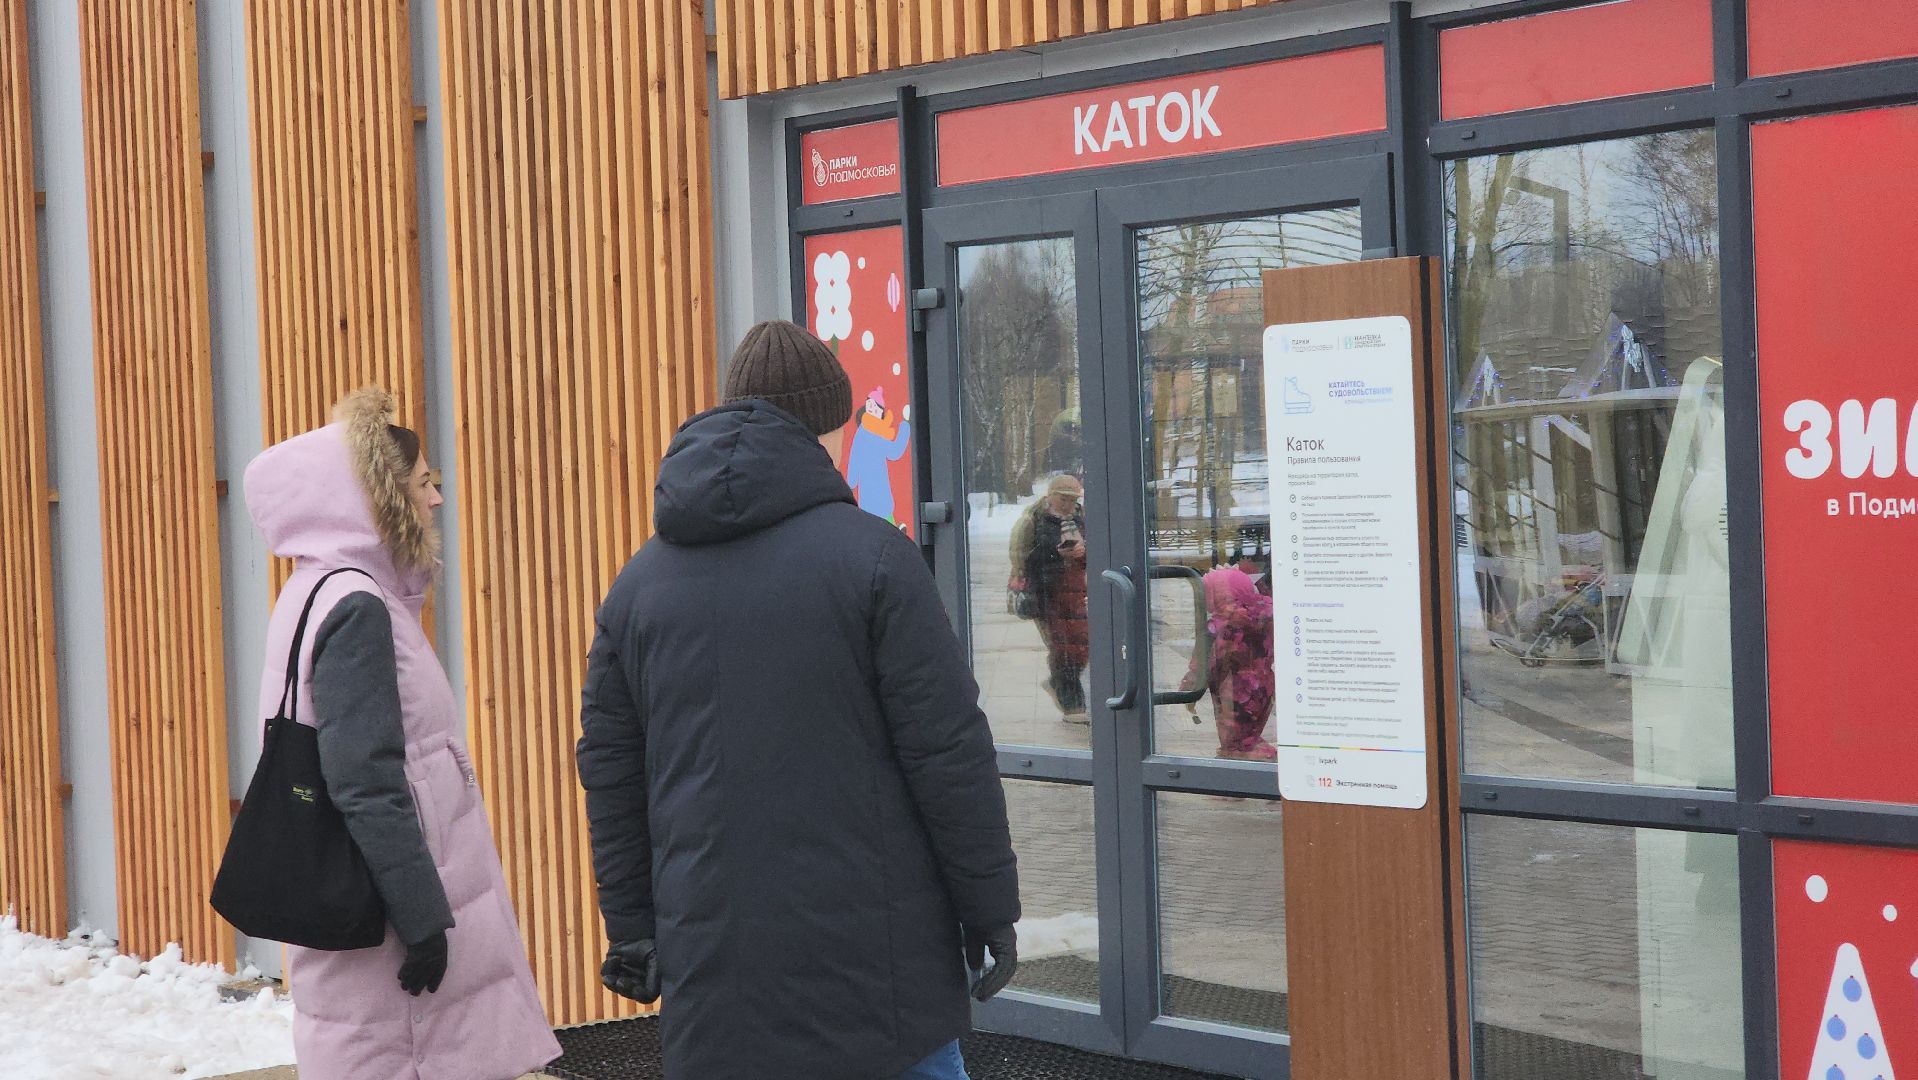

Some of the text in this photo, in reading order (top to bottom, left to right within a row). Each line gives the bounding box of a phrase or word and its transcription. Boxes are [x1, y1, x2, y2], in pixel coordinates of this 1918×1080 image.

[1074, 85, 1223, 155] КАТОК
[829, 155, 858, 170] ПАРКИ
[829, 163, 896, 183] ПОДМОСКОВЬЯ
[1328, 380, 1365, 389] КАТАЙТЕСЬ
[1334, 387, 1393, 398] УДОВОЛЬСТВИЕМ
[1286, 436, 1325, 451] Каток
[1783, 398, 1918, 479] ЗИ
[1287, 455, 1361, 466] Правила пользования
[1827, 492, 1918, 518] в Подм
[1318, 777, 1332, 787] 112
